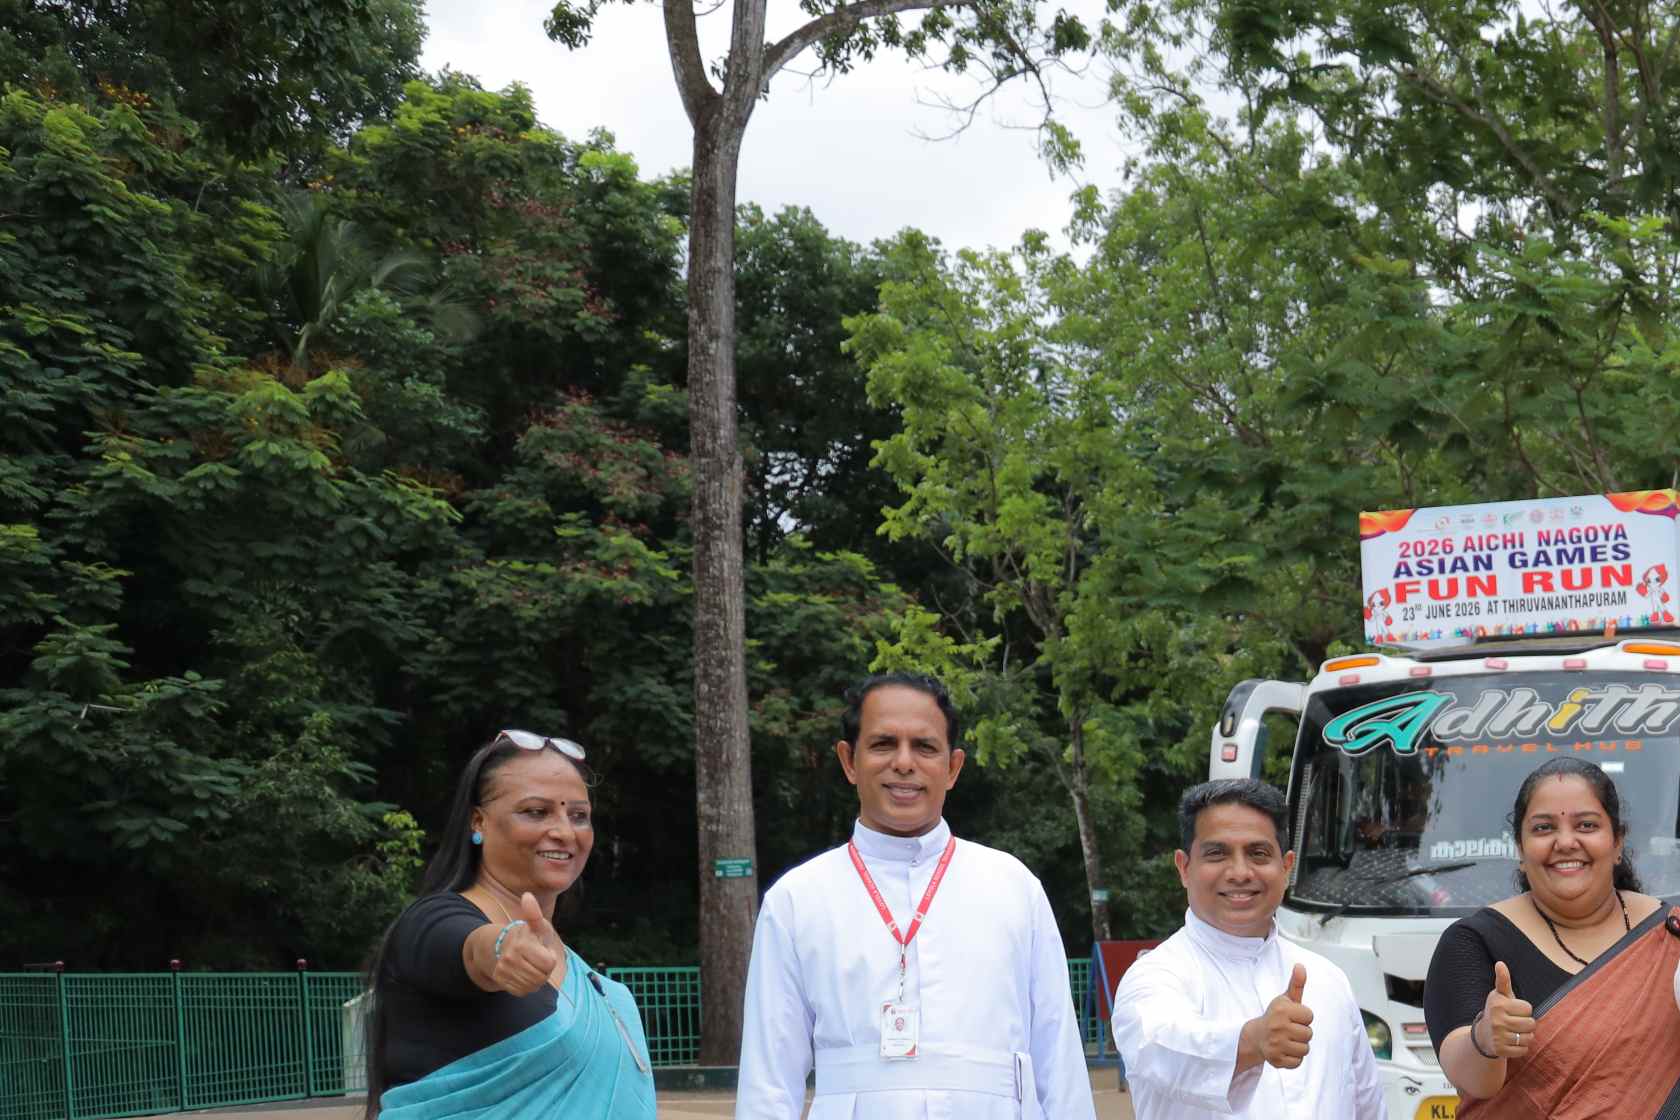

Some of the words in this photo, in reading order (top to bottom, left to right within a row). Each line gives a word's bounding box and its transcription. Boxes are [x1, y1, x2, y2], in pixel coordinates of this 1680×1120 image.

[1399, 538, 1454, 558] 2026
[1463, 531, 1525, 553] AICHI
[1537, 523, 1628, 547] NAGOYA
[1393, 553, 1493, 578] ASIAN
[1508, 542, 1631, 569] GAMES
[1395, 574, 1498, 604] FUN
[1522, 563, 1633, 594] RUN
[1425, 602, 1451, 620] JUNE
[1454, 600, 1481, 617] 2026
[1487, 600, 1499, 615] AT
[1502, 591, 1628, 615] THIRUVANANTHAPURAM
[1431, 1104, 1457, 1120] KL.
